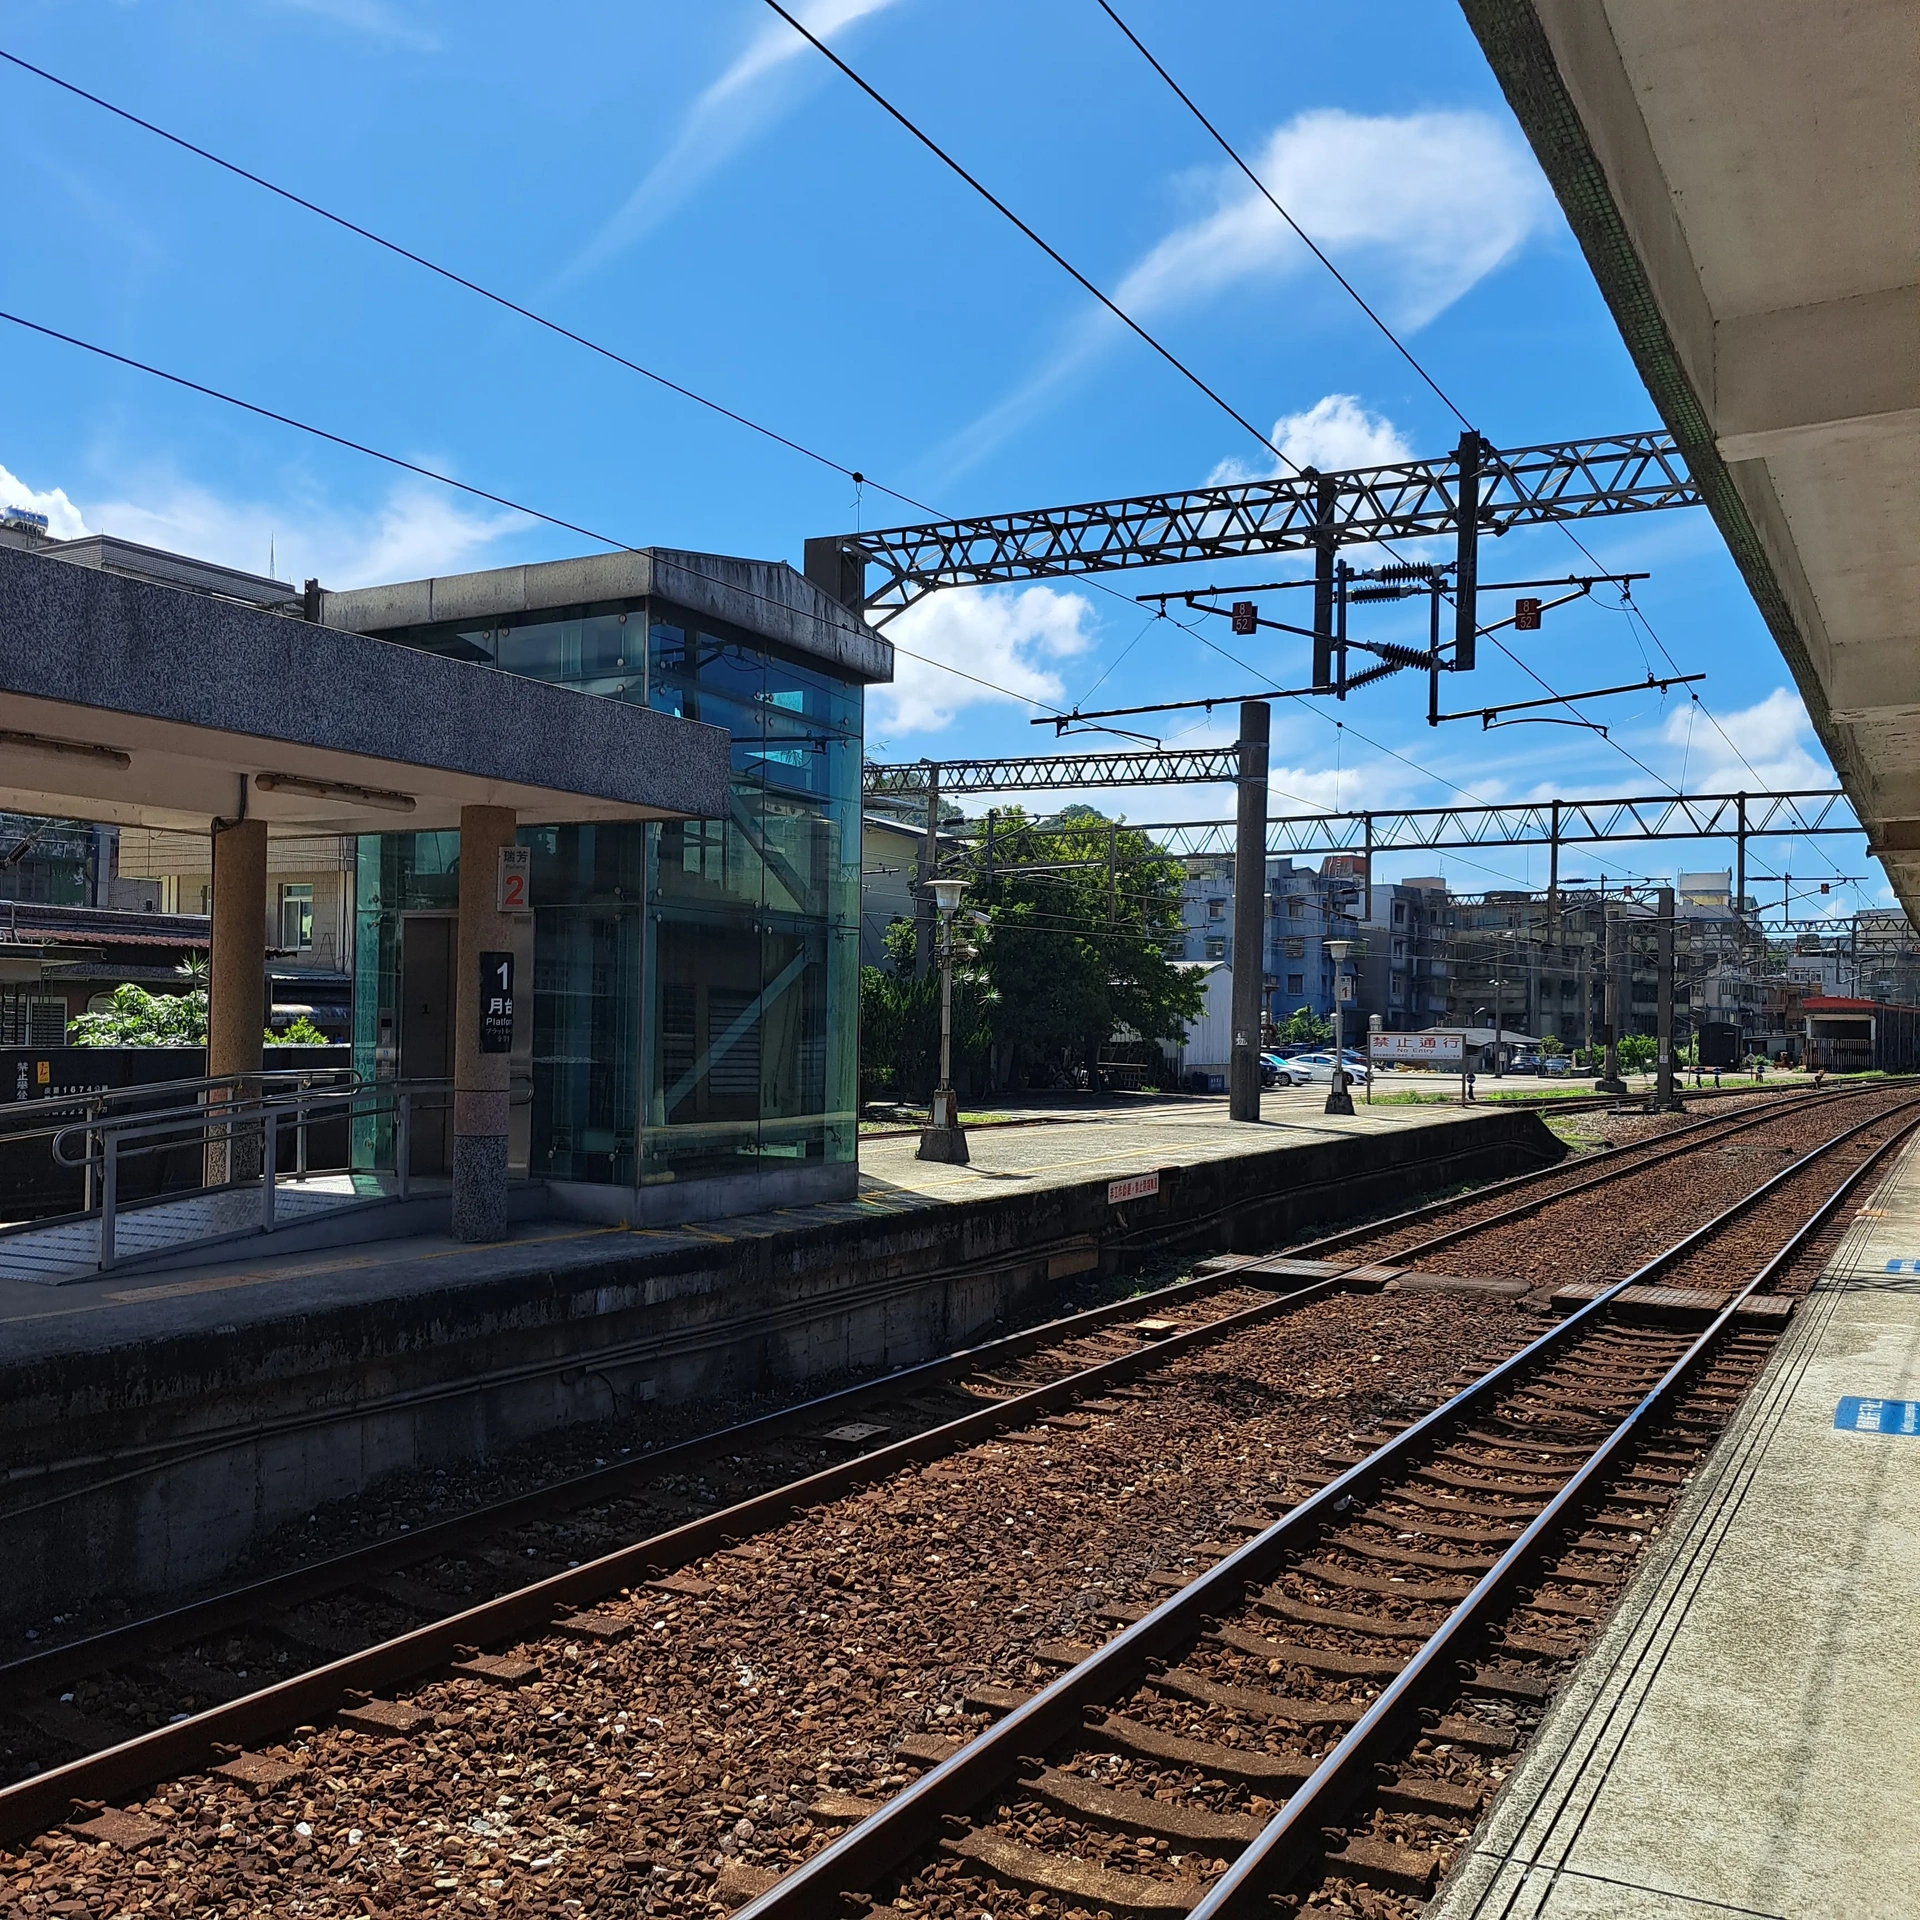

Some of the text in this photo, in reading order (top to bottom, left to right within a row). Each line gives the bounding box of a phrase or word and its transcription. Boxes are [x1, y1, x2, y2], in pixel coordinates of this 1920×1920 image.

[1240, 603, 1245, 615] 8
[1524, 600, 1529, 612] 8
[1236, 618, 1247, 630] 52
[1520, 616, 1532, 628] 52
[504, 851, 528, 863] 瑞芳
[505, 875, 524, 905] 2
[497, 962, 508, 990] 1
[1342, 986, 1347, 998] 1
[1373, 1036, 1460, 1048] 禁止通行
